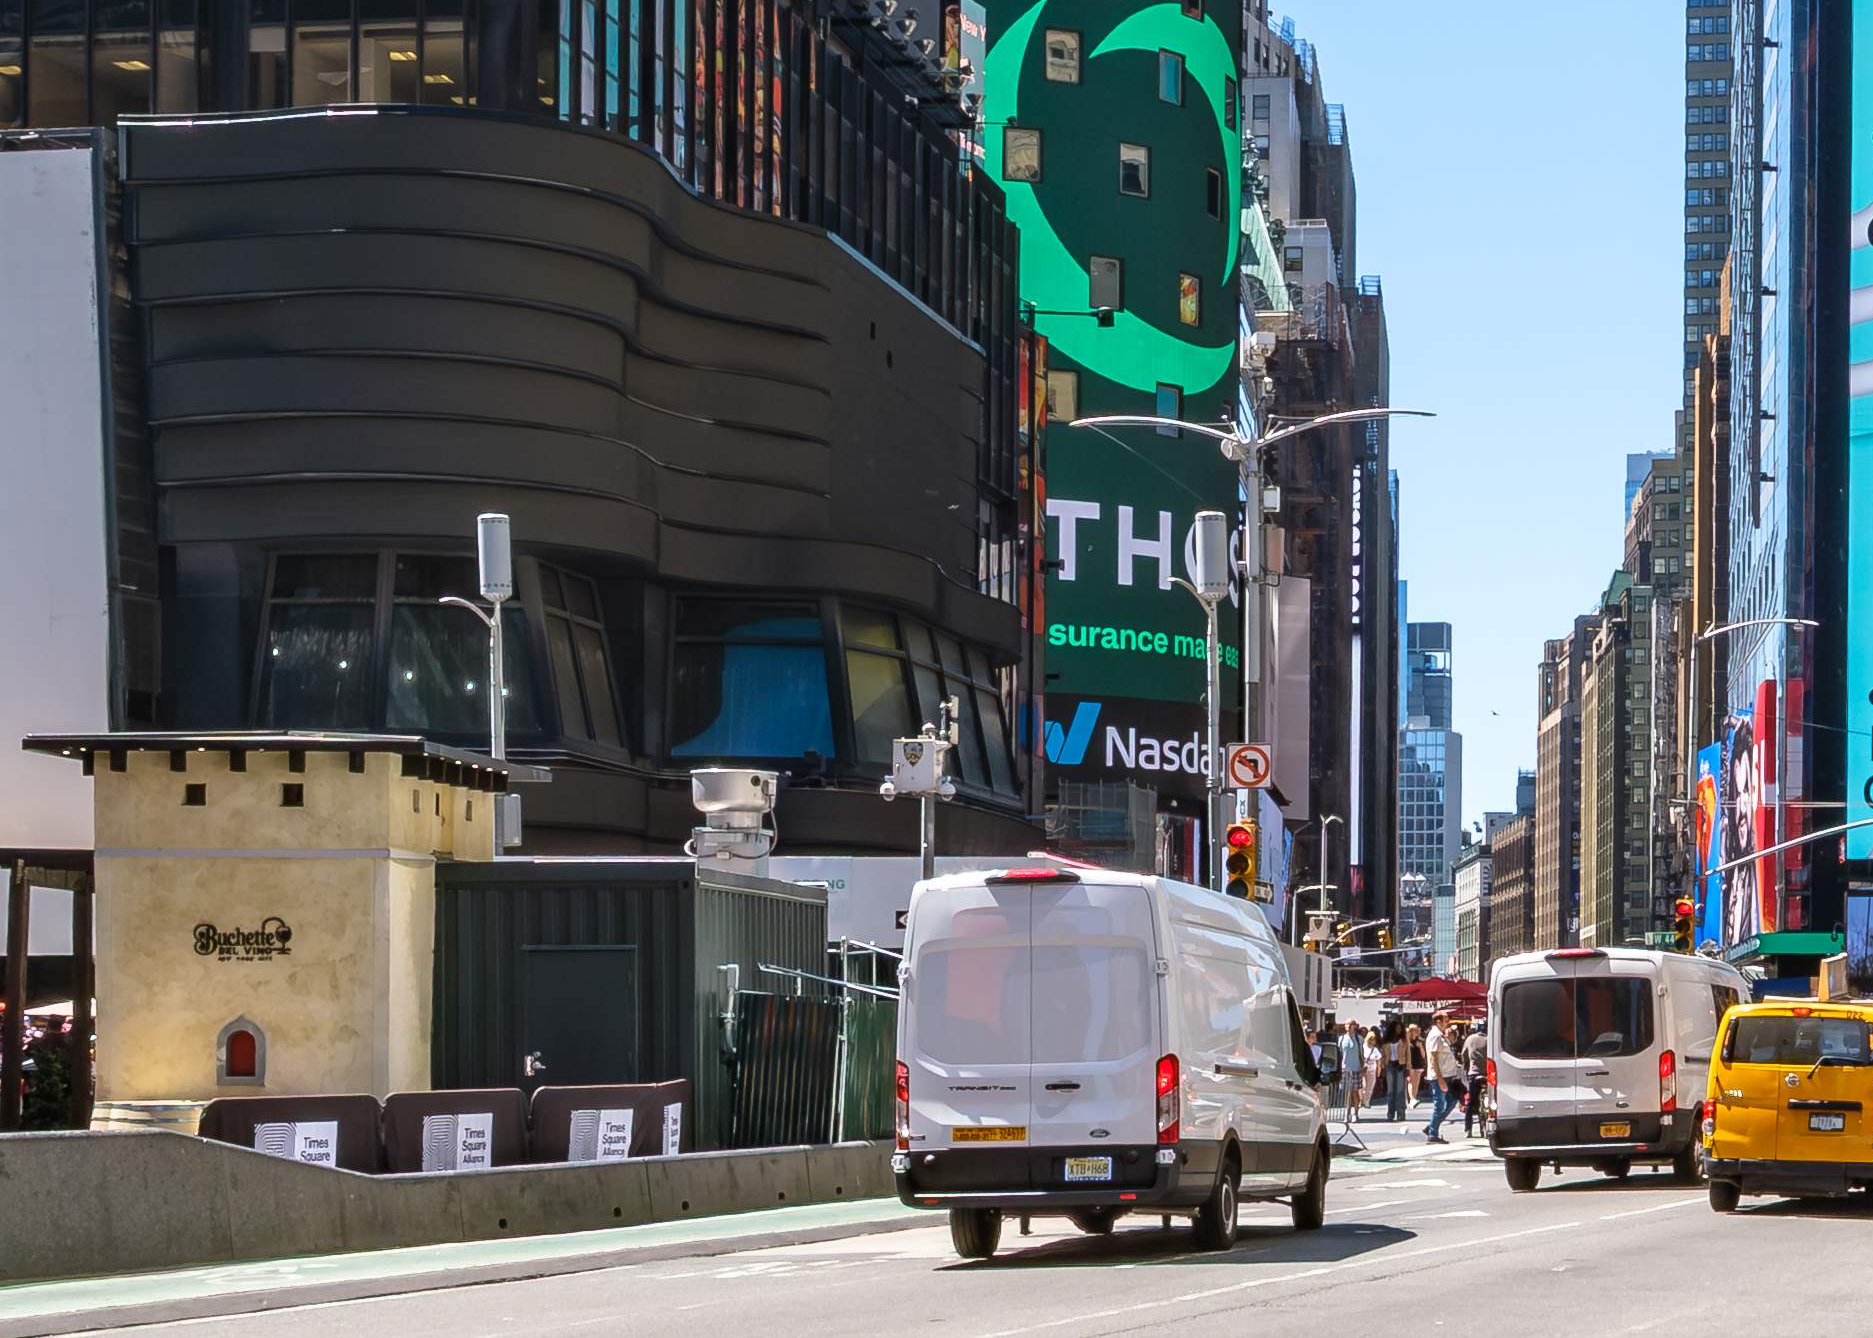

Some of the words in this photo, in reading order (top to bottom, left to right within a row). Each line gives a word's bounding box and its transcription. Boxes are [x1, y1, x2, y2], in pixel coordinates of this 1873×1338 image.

[1049, 622, 1169, 654] surance
[193, 922, 276, 956] Buchette
[1416, 1000, 1437, 1009] NEW
[464, 1127, 486, 1139] Times
[604, 1122, 626, 1133] Times
[303, 1136, 329, 1149] Times
[461, 1140, 487, 1153] Square
[602, 1133, 627, 1147] Square
[300, 1150, 331, 1163] Square
